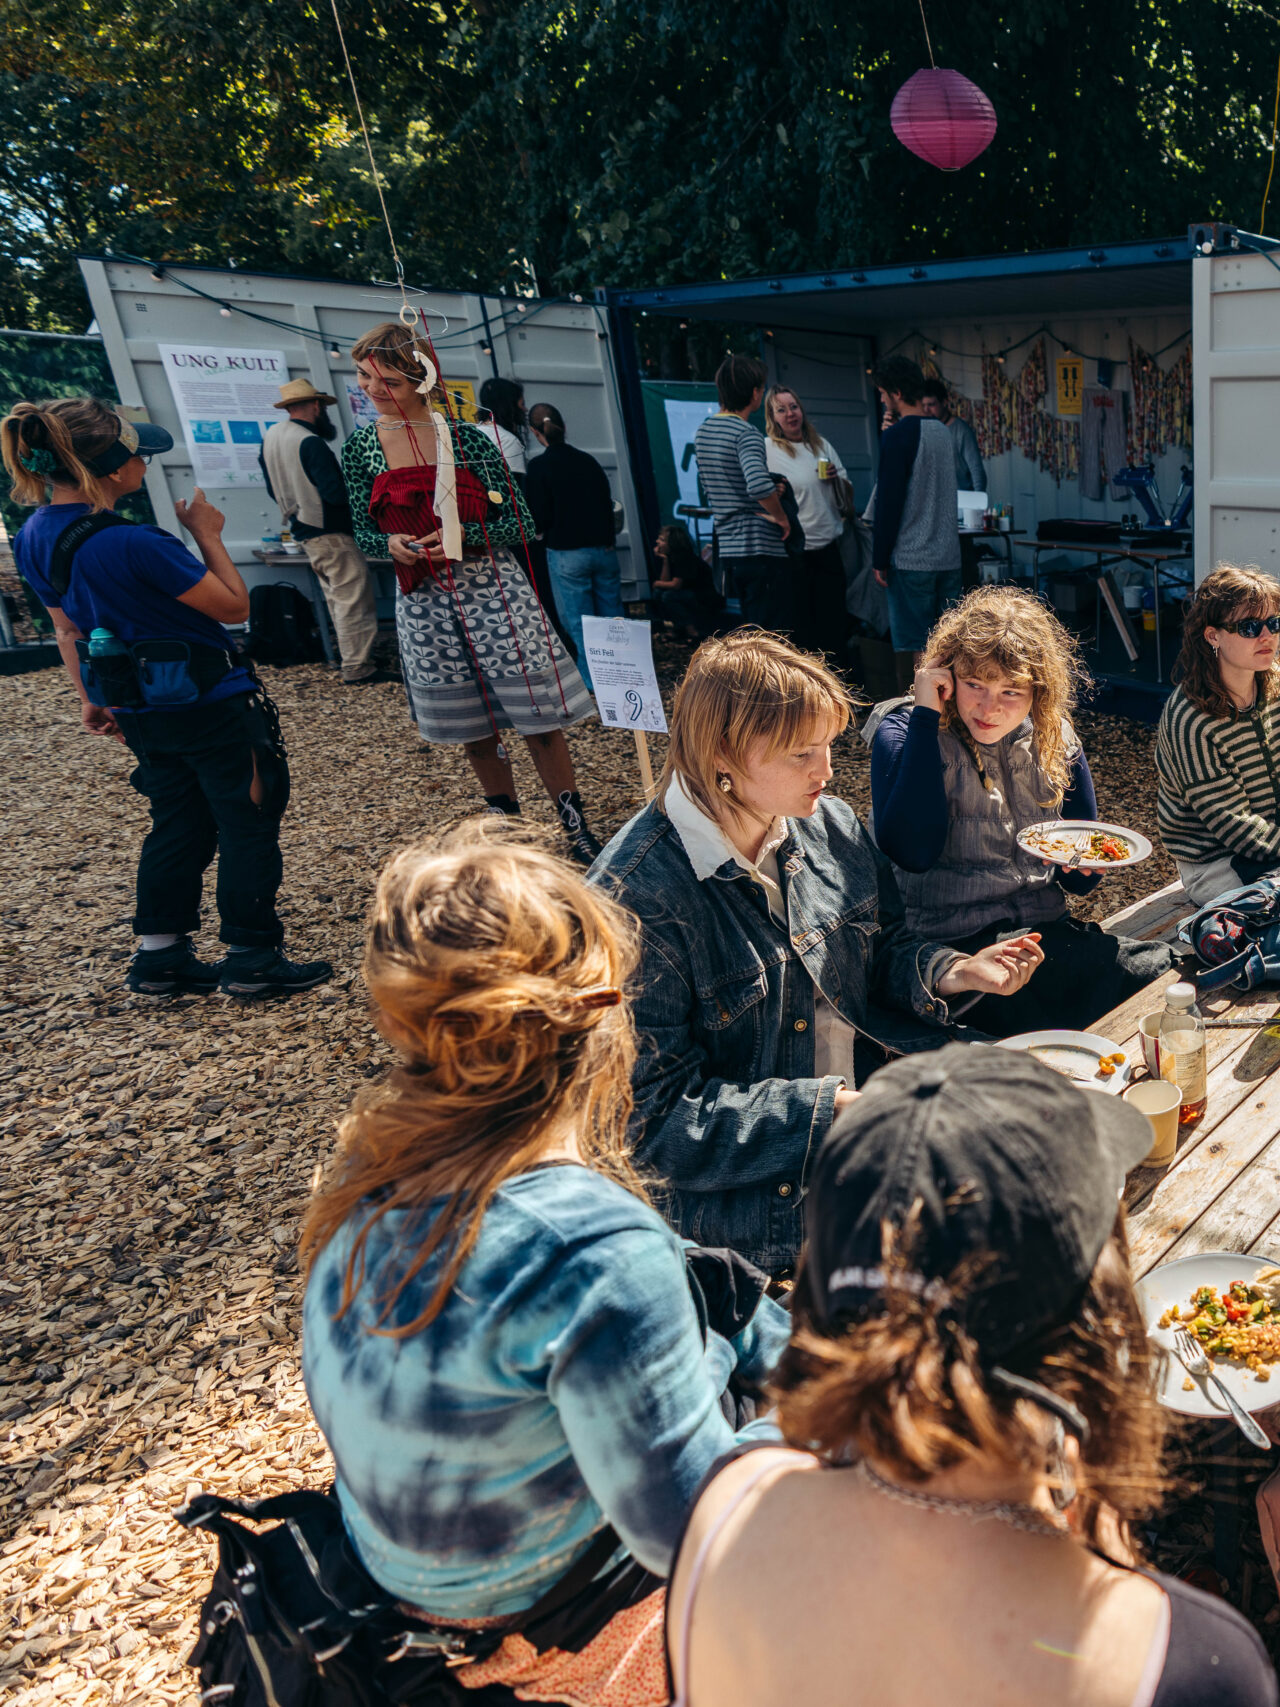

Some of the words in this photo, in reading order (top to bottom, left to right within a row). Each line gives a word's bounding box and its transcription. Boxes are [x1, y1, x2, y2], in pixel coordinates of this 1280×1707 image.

[171, 353, 219, 369] UNG
[226, 356, 279, 372] KULT
[60, 520, 93, 552] FUJIFILM
[589, 647, 602, 656] Siri
[602, 648, 615, 657] Feil
[625, 689, 643, 721] 9
